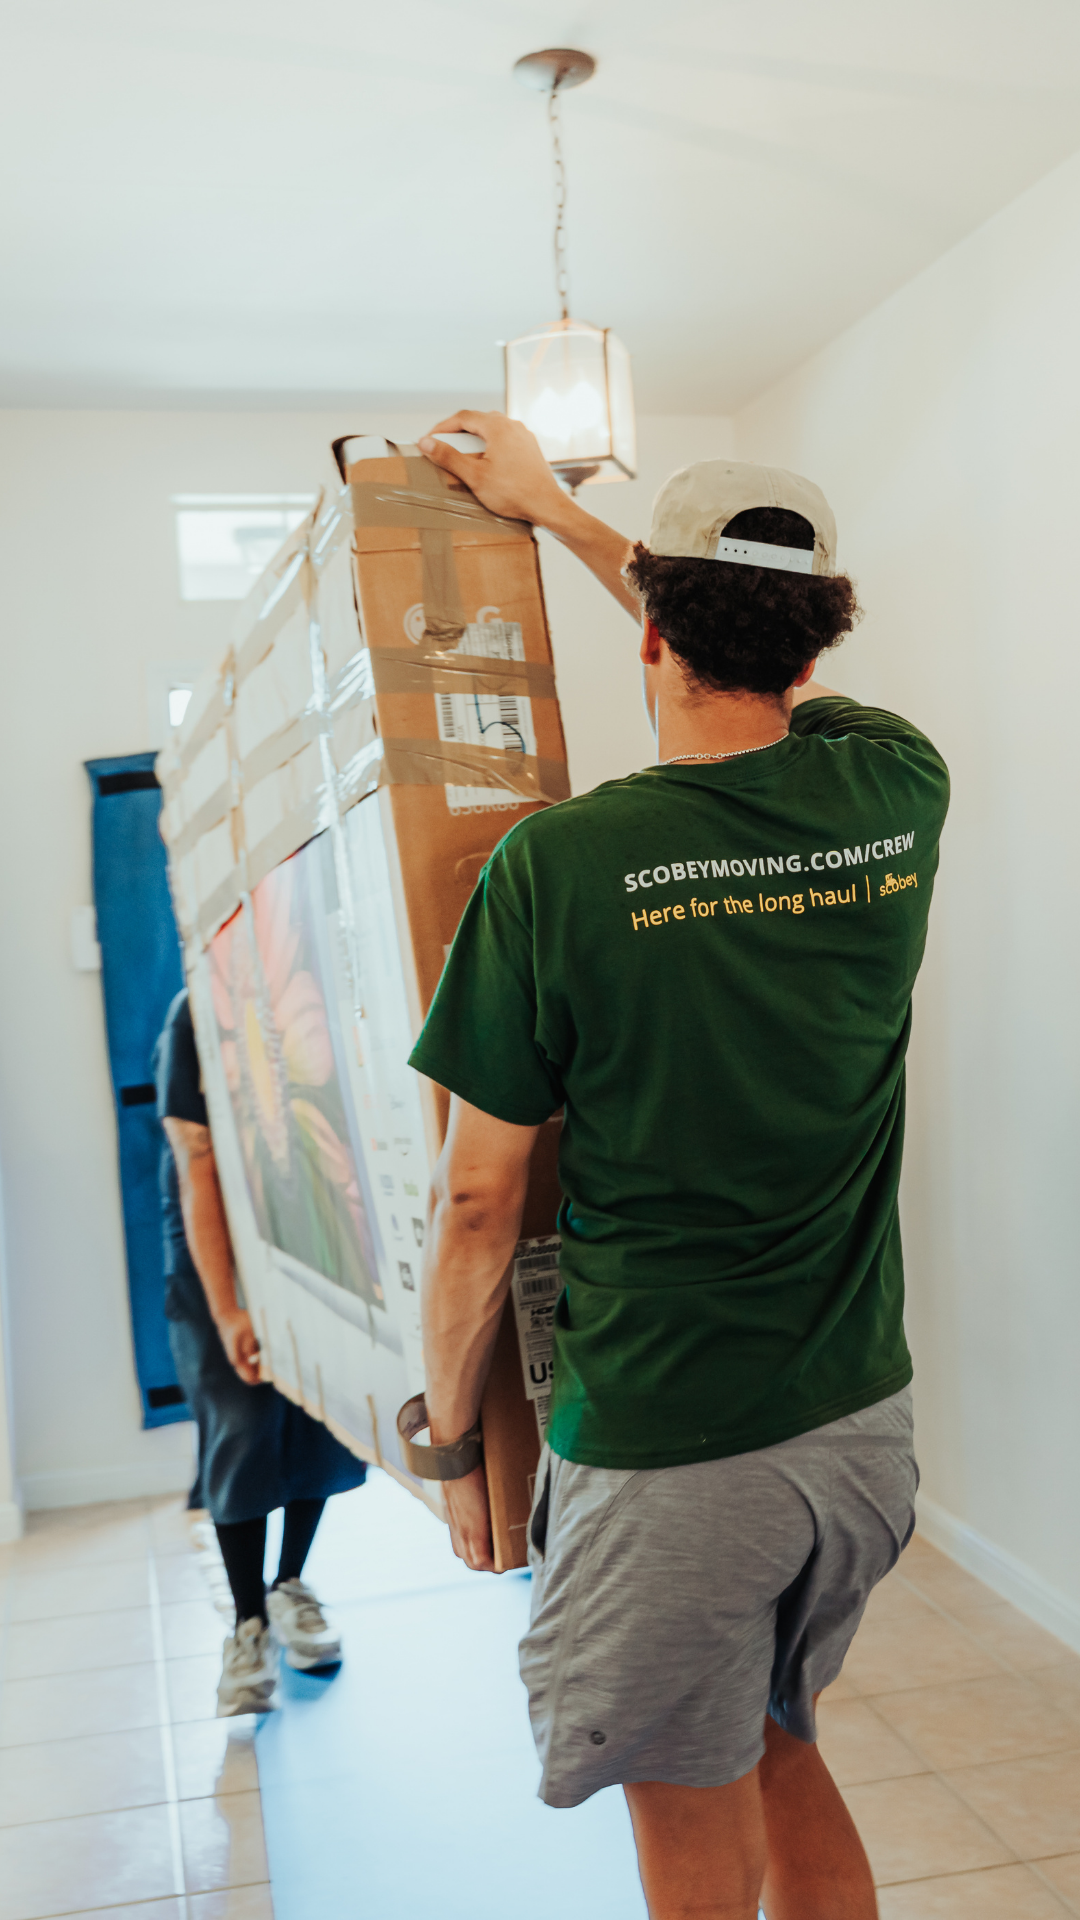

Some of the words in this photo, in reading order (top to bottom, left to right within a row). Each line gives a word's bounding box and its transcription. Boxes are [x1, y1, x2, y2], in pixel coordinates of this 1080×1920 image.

[624, 830, 915, 892] SCOBEYMOVING.COM/CREW
[879, 872, 918, 897] scobey
[631, 908, 686, 931] Here
[689, 897, 719, 918] for
[723, 895, 754, 915] the
[758, 892, 805, 915] long
[809, 883, 857, 907] haul
